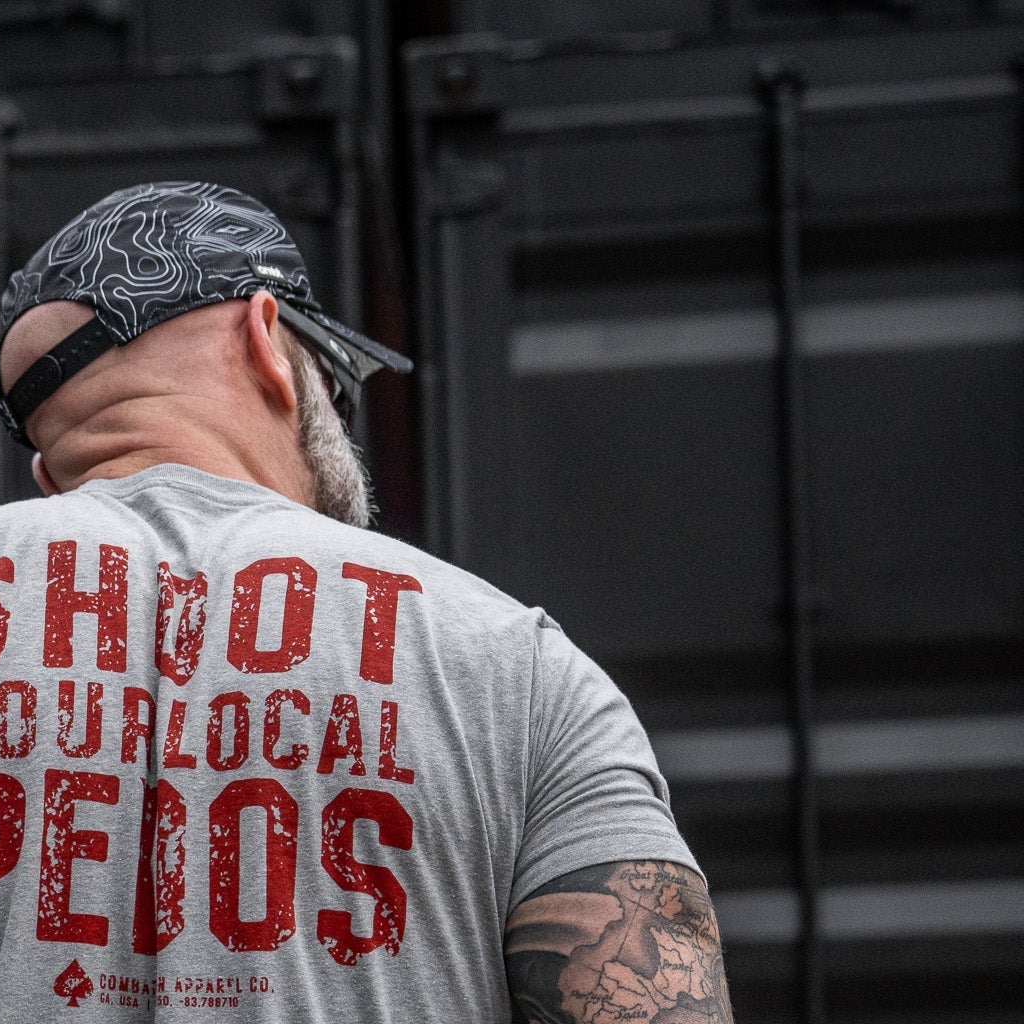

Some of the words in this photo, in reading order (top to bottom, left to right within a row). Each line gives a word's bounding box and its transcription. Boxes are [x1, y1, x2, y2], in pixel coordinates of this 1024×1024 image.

[162, 689, 415, 785] LOCAL
[119, 995, 138, 1008] USA
[615, 1007, 649, 1022] Spain
